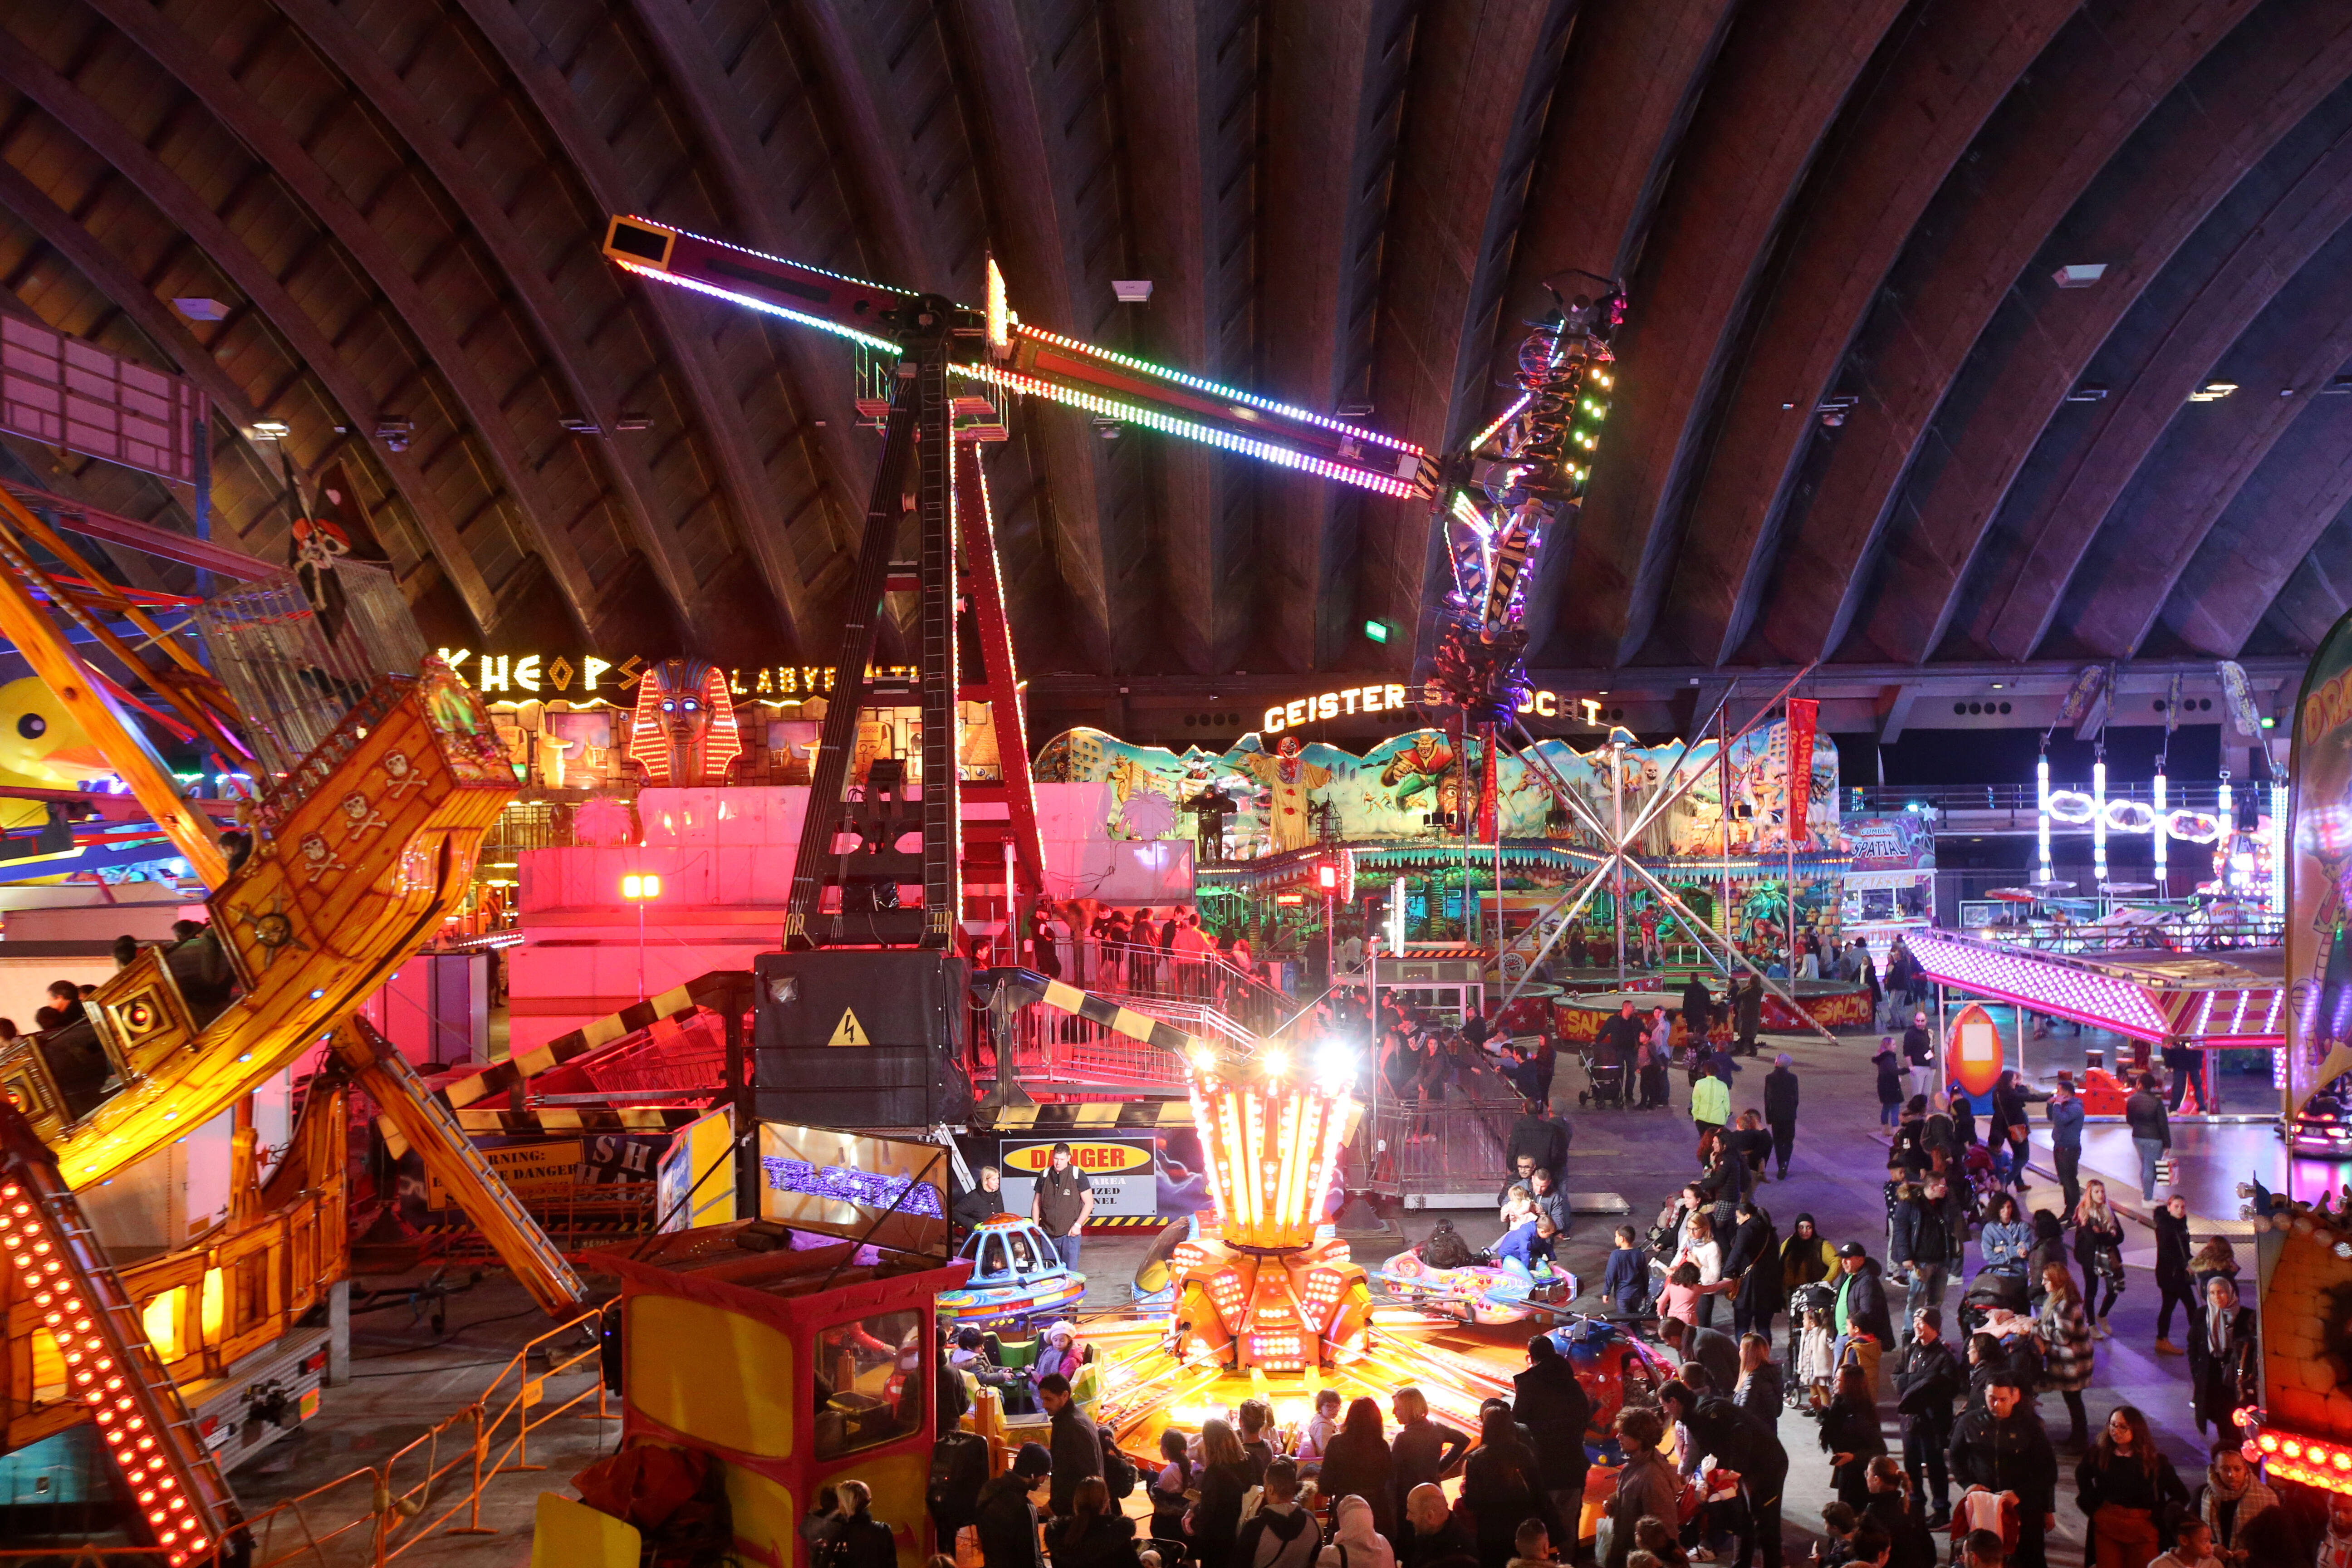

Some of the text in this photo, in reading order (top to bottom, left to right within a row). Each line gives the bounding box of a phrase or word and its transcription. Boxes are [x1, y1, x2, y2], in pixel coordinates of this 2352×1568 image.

[1264, 682, 1406, 734] GEISTER
[1861, 827, 1892, 836] COMBAT
[1851, 840, 1909, 859] SPATIAL
[1814, 995, 1871, 1022] SALTO
[514, 1164, 579, 1180] DANGER
